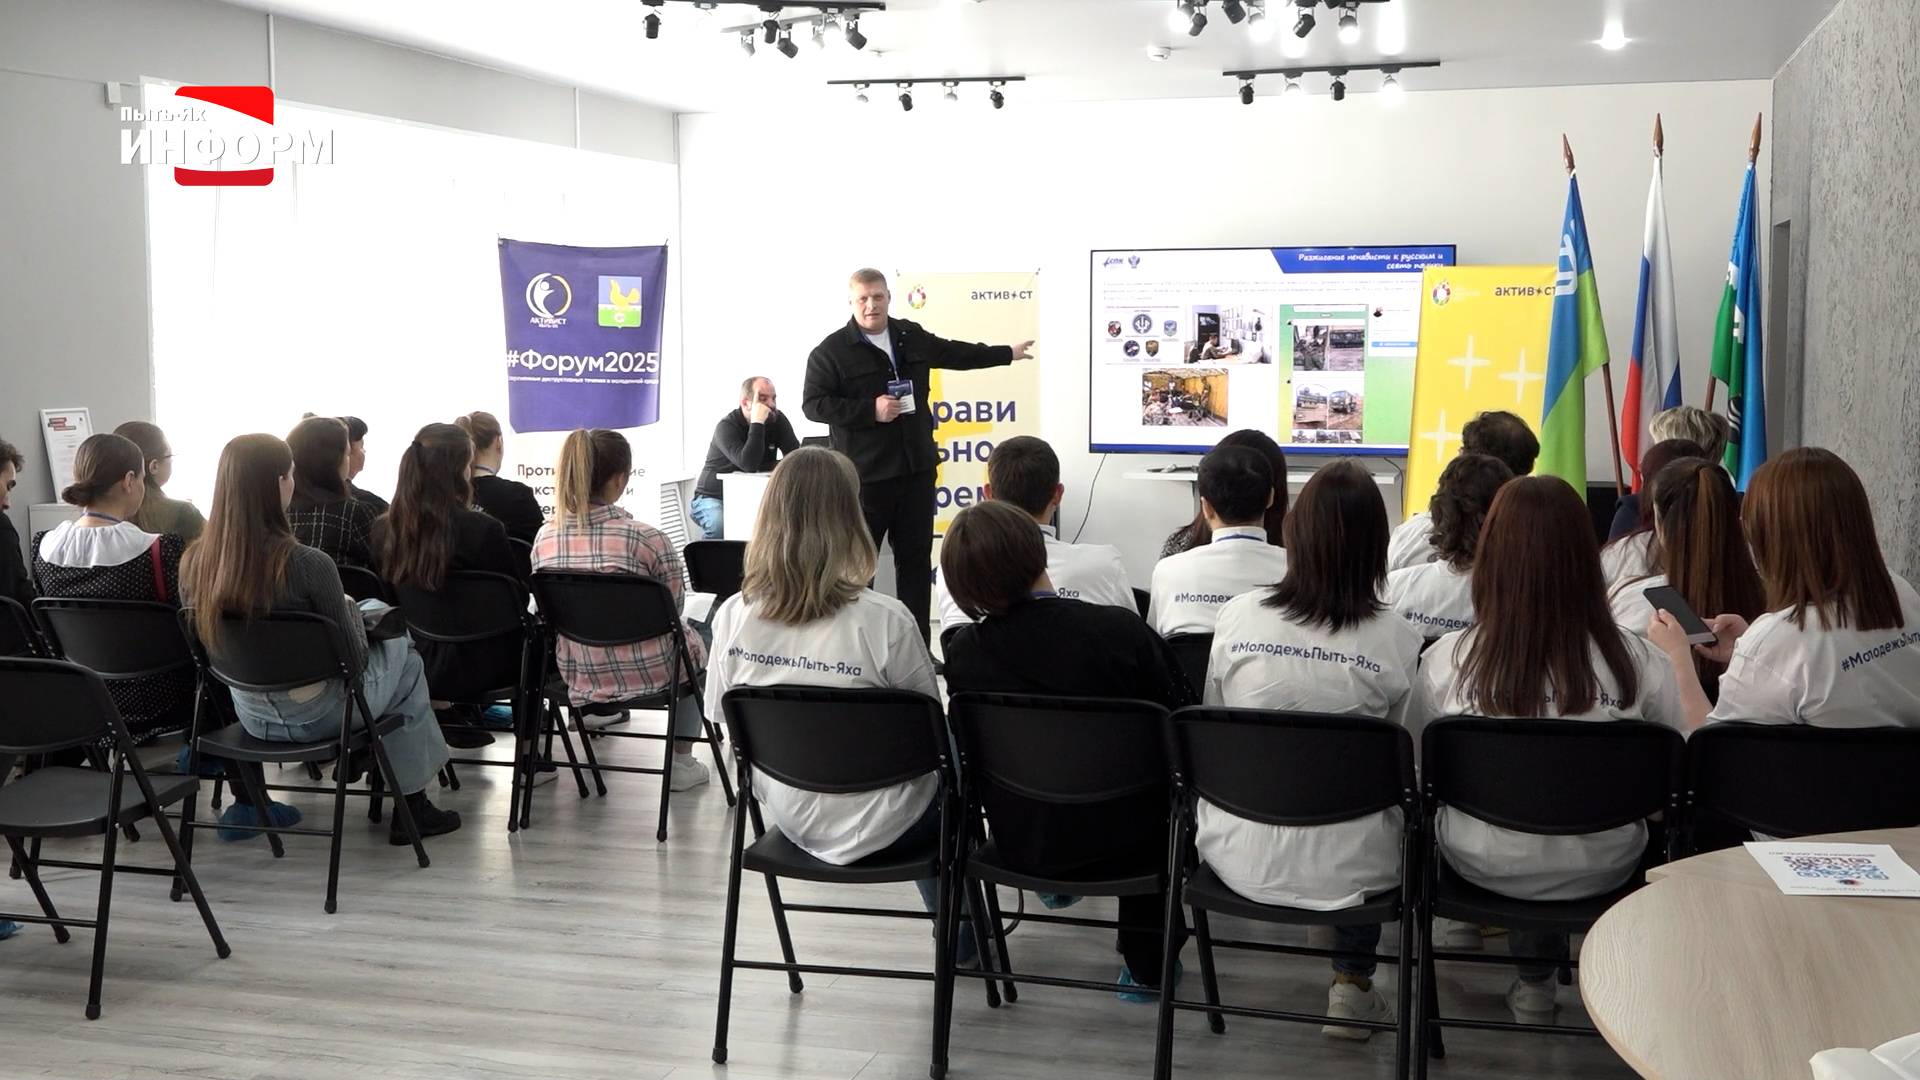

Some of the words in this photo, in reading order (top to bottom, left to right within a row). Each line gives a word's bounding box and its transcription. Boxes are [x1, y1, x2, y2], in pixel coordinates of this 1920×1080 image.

[506, 349, 660, 376] #Форум2025
[932, 400, 1016, 430] рави
[1231, 641, 1381, 673] #МолодежьПыть-Яха
